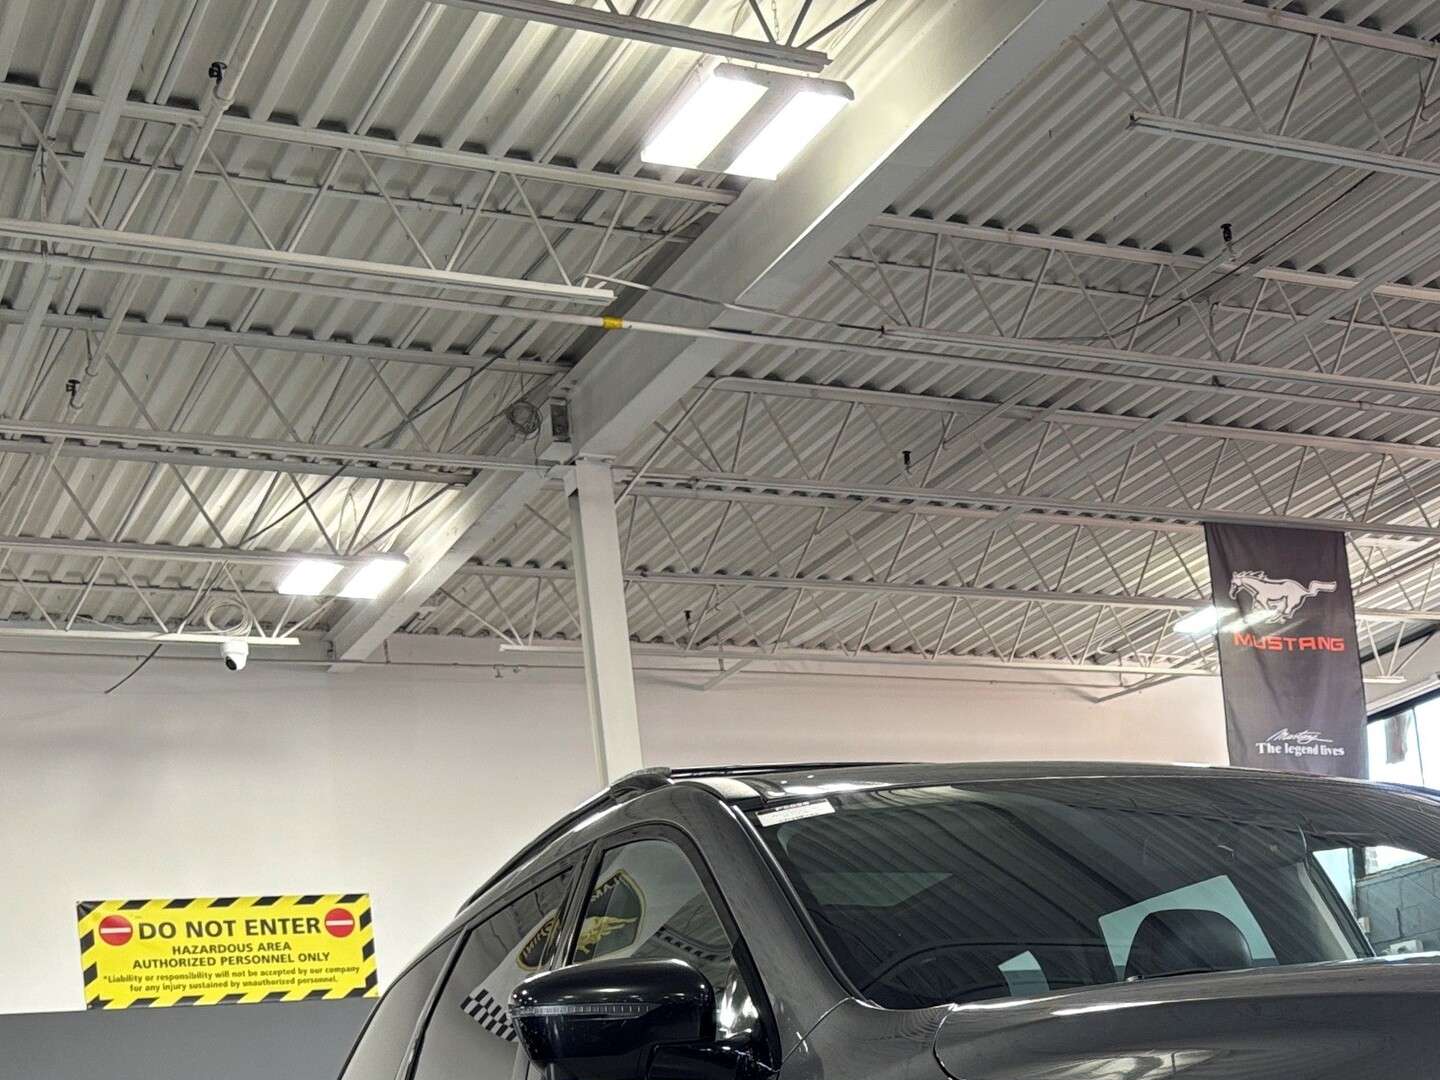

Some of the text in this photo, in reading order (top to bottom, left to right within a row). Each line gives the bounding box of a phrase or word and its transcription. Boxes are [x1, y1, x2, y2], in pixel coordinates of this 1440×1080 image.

[1233, 631, 1345, 652] MUSTANG
[1256, 742, 1345, 757] The legend lives
[138, 917, 321, 940] DO NOT ENTER
[172, 941, 292, 956] HAZARDOUS AREA
[133, 951, 330, 970] AUTHORIZED PERSONNEL ONLY
[156, 971, 213, 983] responsibility
[215, 970, 230, 978] will
[248, 969, 259, 977] be
[260, 968, 296, 978] accepted
[297, 967, 309, 976] by
[325, 966, 360, 975] company
[130, 984, 142, 992] for
[144, 984, 160, 993] any
[162, 983, 187, 993] injury
[189, 981, 229, 989] sustained
[230, 981, 241, 989] by
[242, 978, 296, 988] unauthorized
